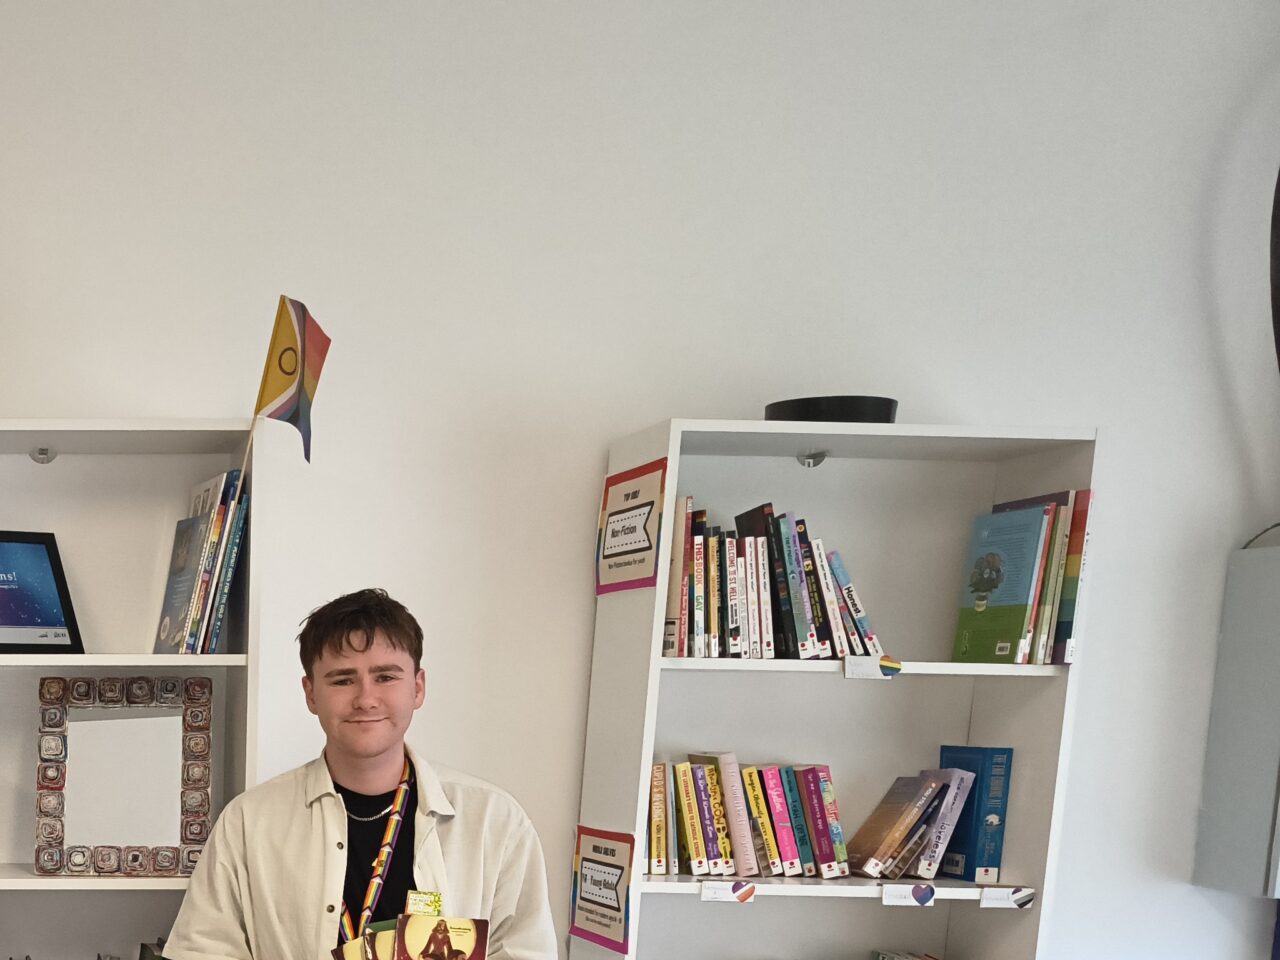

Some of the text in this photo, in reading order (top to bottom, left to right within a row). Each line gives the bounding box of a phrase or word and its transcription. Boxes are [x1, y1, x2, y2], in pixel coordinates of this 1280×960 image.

[695, 542, 703, 565] THIS
[727, 540, 737, 572] WELCOME
[695, 565, 703, 586] BOOK
[843, 586, 862, 616] Honest.
[712, 801, 725, 825] COW
[693, 841, 701, 858] SCHOOL
[927, 820, 950, 861] loveless
